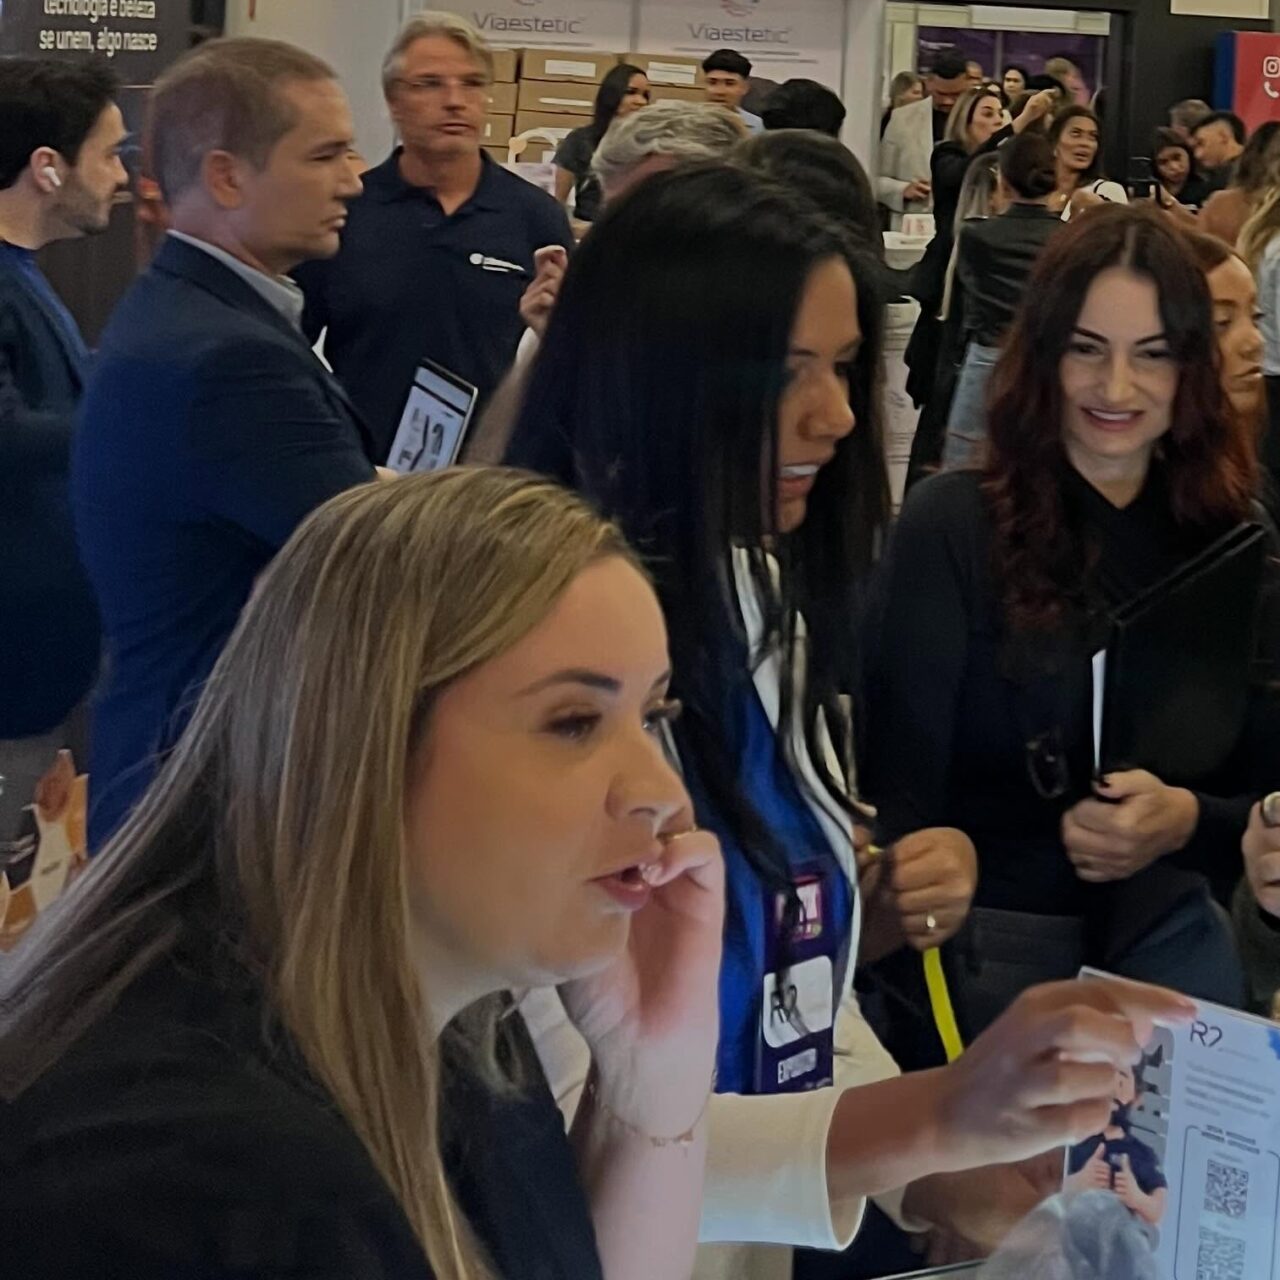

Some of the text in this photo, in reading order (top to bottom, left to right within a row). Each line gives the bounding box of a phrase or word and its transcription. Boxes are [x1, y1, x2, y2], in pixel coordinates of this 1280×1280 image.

[474, 12, 582, 34] Viaestetic
[40, 30, 55, 50] se
[97, 26, 122, 57] algo
